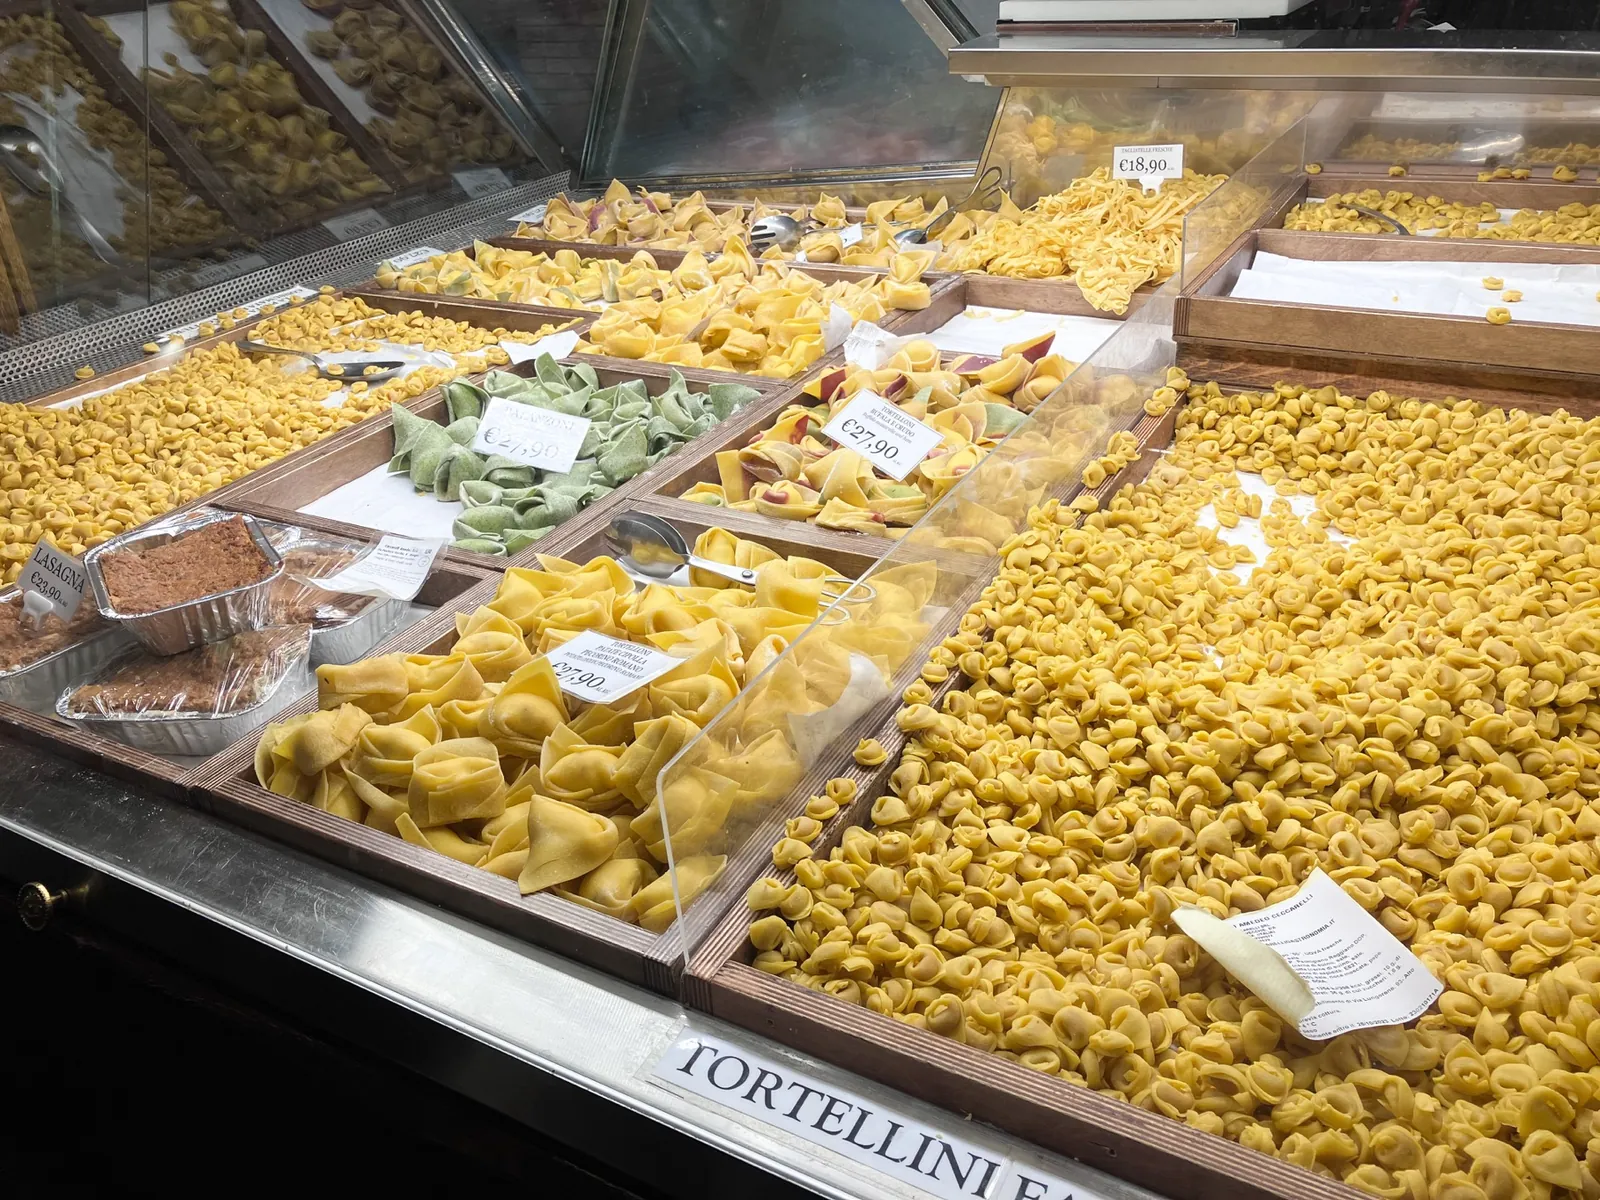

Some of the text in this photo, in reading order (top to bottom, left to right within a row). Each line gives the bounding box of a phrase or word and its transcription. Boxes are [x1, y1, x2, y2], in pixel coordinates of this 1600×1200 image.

[1119, 156, 1167, 174] €18,90
[870, 408, 891, 424] BUFALA
[894, 422, 916, 437] CRUDO
[881, 406, 916, 429] TORTELLONI
[484, 426, 560, 458] €27,90
[841, 418, 899, 460] €27,90
[33, 547, 86, 594] LASAGNA
[30, 571, 62, 601] €23,90
[595, 644, 619, 659] PATATE
[617, 650, 648, 666] CIPOLLA
[610, 641, 653, 657] TORTELLONI
[611, 656, 644, 673] ROMANO
[1271, 893, 1314, 918] CECCARELLI
[676, 1040, 1002, 1199] TORTELLINI
